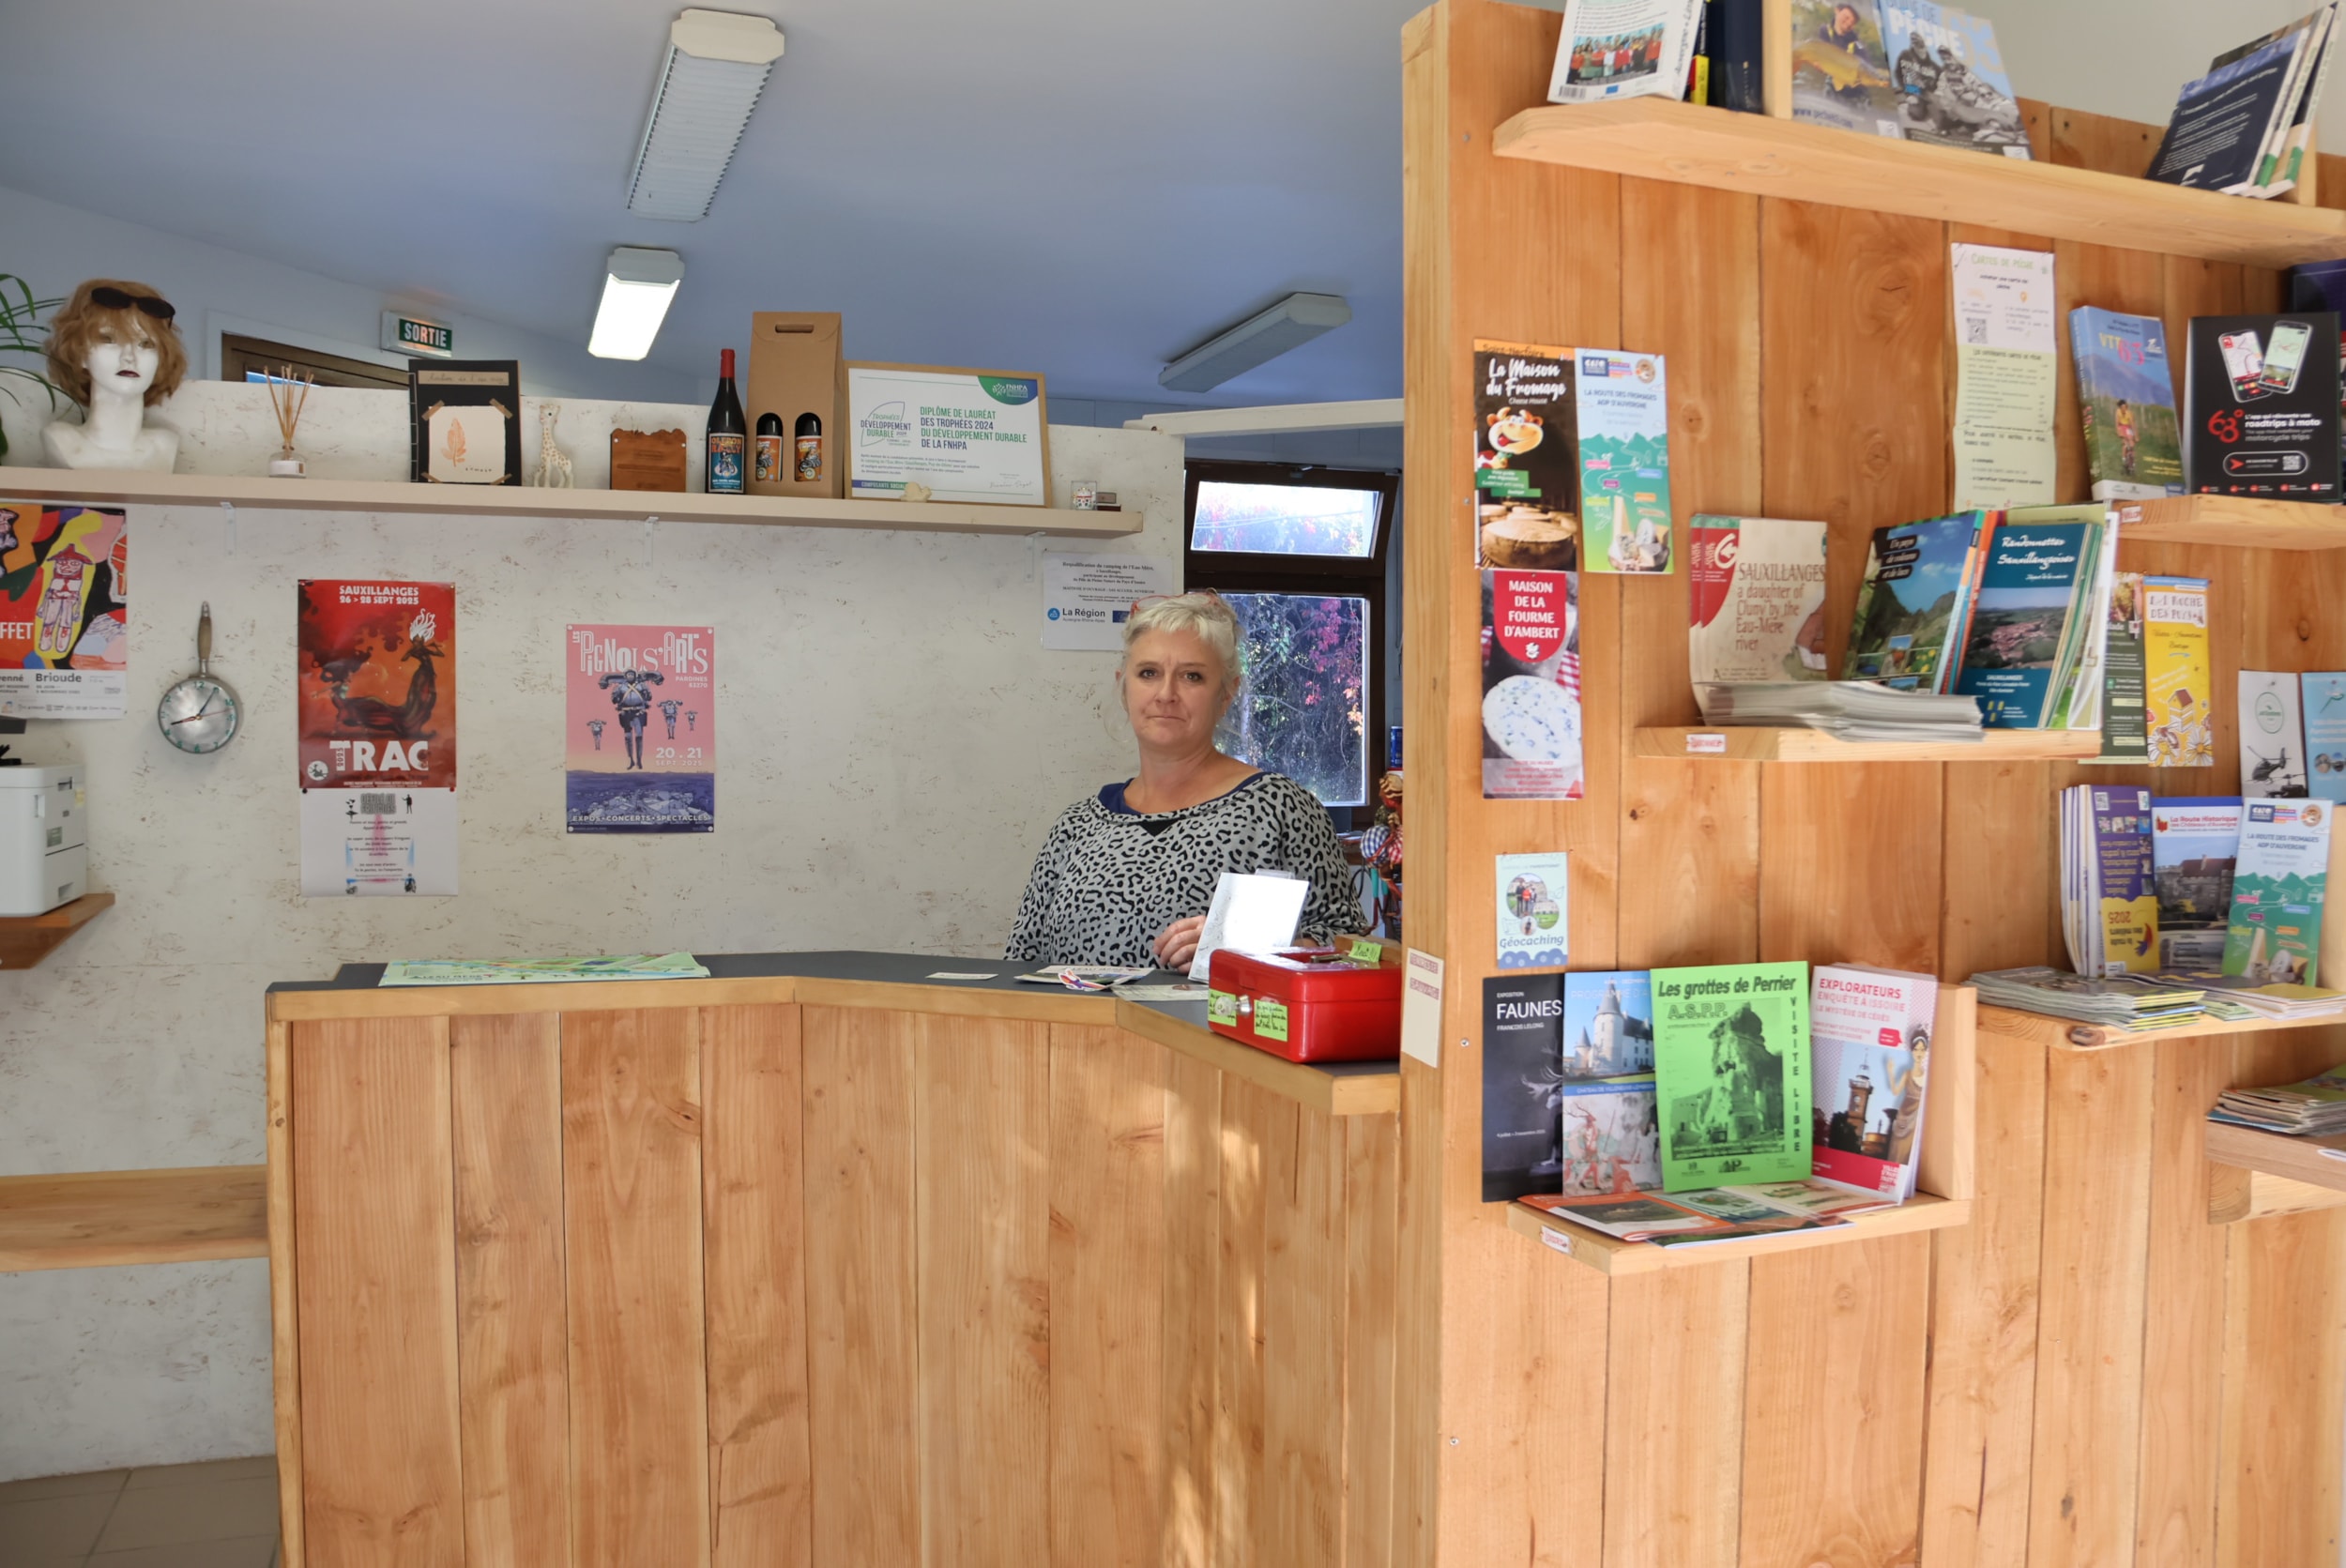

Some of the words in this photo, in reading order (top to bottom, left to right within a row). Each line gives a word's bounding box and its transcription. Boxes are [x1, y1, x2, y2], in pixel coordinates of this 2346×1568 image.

[404, 323, 447, 347] SORTIE
[2099, 333, 2121, 348] VTT
[2118, 340, 2144, 365] 63
[1488, 358, 1506, 378] La
[1508, 358, 1561, 378] Maison
[1485, 377, 1502, 396] du
[1504, 377, 1566, 402] Fromage
[920, 405, 952, 417] DIPLÔME
[952, 408, 963, 418] DE
[964, 408, 996, 419] LAURÉAT
[861, 419, 911, 431] DÉVELOPPEMENT
[921, 417, 935, 427] DES
[937, 418, 974, 429] TROPHÉES
[974, 420, 994, 430] 2024
[2245, 419, 2287, 428] roadtrips
[2288, 419, 2295, 427] à
[867, 429, 894, 438] DURABLE
[921, 428, 931, 437] DU
[933, 428, 993, 441] DÉVELOPPEMENT
[995, 434, 1027, 443] DURABLE
[2291, 434, 2310, 442] trips
[922, 439, 931, 448] DE
[933, 439, 942, 449] LA
[943, 440, 967, 450] FNHPA
[1738, 563, 1826, 582] SAUXILLANGES
[340, 586, 419, 596] SAUXILLANGES
[1509, 581, 1553, 594] MAISON
[1737, 587, 1744, 599] a
[1745, 584, 1790, 601] daughter
[1793, 583, 1805, 599] of
[396, 597, 419, 605] 2025
[1515, 596, 1529, 608] DE
[1531, 597, 1546, 608] LA
[1074, 608, 1105, 617] Région
[1769, 600, 1781, 618] by
[1782, 601, 1800, 617] the
[1508, 611, 1555, 624] FOURME
[1504, 626, 1560, 639] D'AMBERT
[1737, 637, 1759, 651] river
[0, 674, 23, 683] enné
[36, 673, 82, 683] Brioude
[193, 680, 205, 689] 12
[329, 740, 429, 771] TRAC
[656, 747, 675, 759] 20
[687, 747, 702, 759] 21
[2288, 834, 2320, 843] FROMAGES
[2109, 911, 2131, 923] 2025
[1500, 936, 1564, 948] Géocaching
[1658, 981, 1681, 997] Les
[1684, 979, 1730, 1000] grottes
[1733, 977, 1749, 992] de
[1752, 975, 1796, 993] Perrier
[1820, 978, 1901, 998] EXPLORATEURS
[1817, 991, 1859, 1005] ENQUÊTE
[1868, 998, 1906, 1012] ISSOIRE
[1496, 999, 1562, 1020] FAUNES
[1668, 1002, 1728, 1020] A.S.P.P.
[1790, 997, 1799, 1076] VISITE
[1792, 1088, 1801, 1152] LIBRE
